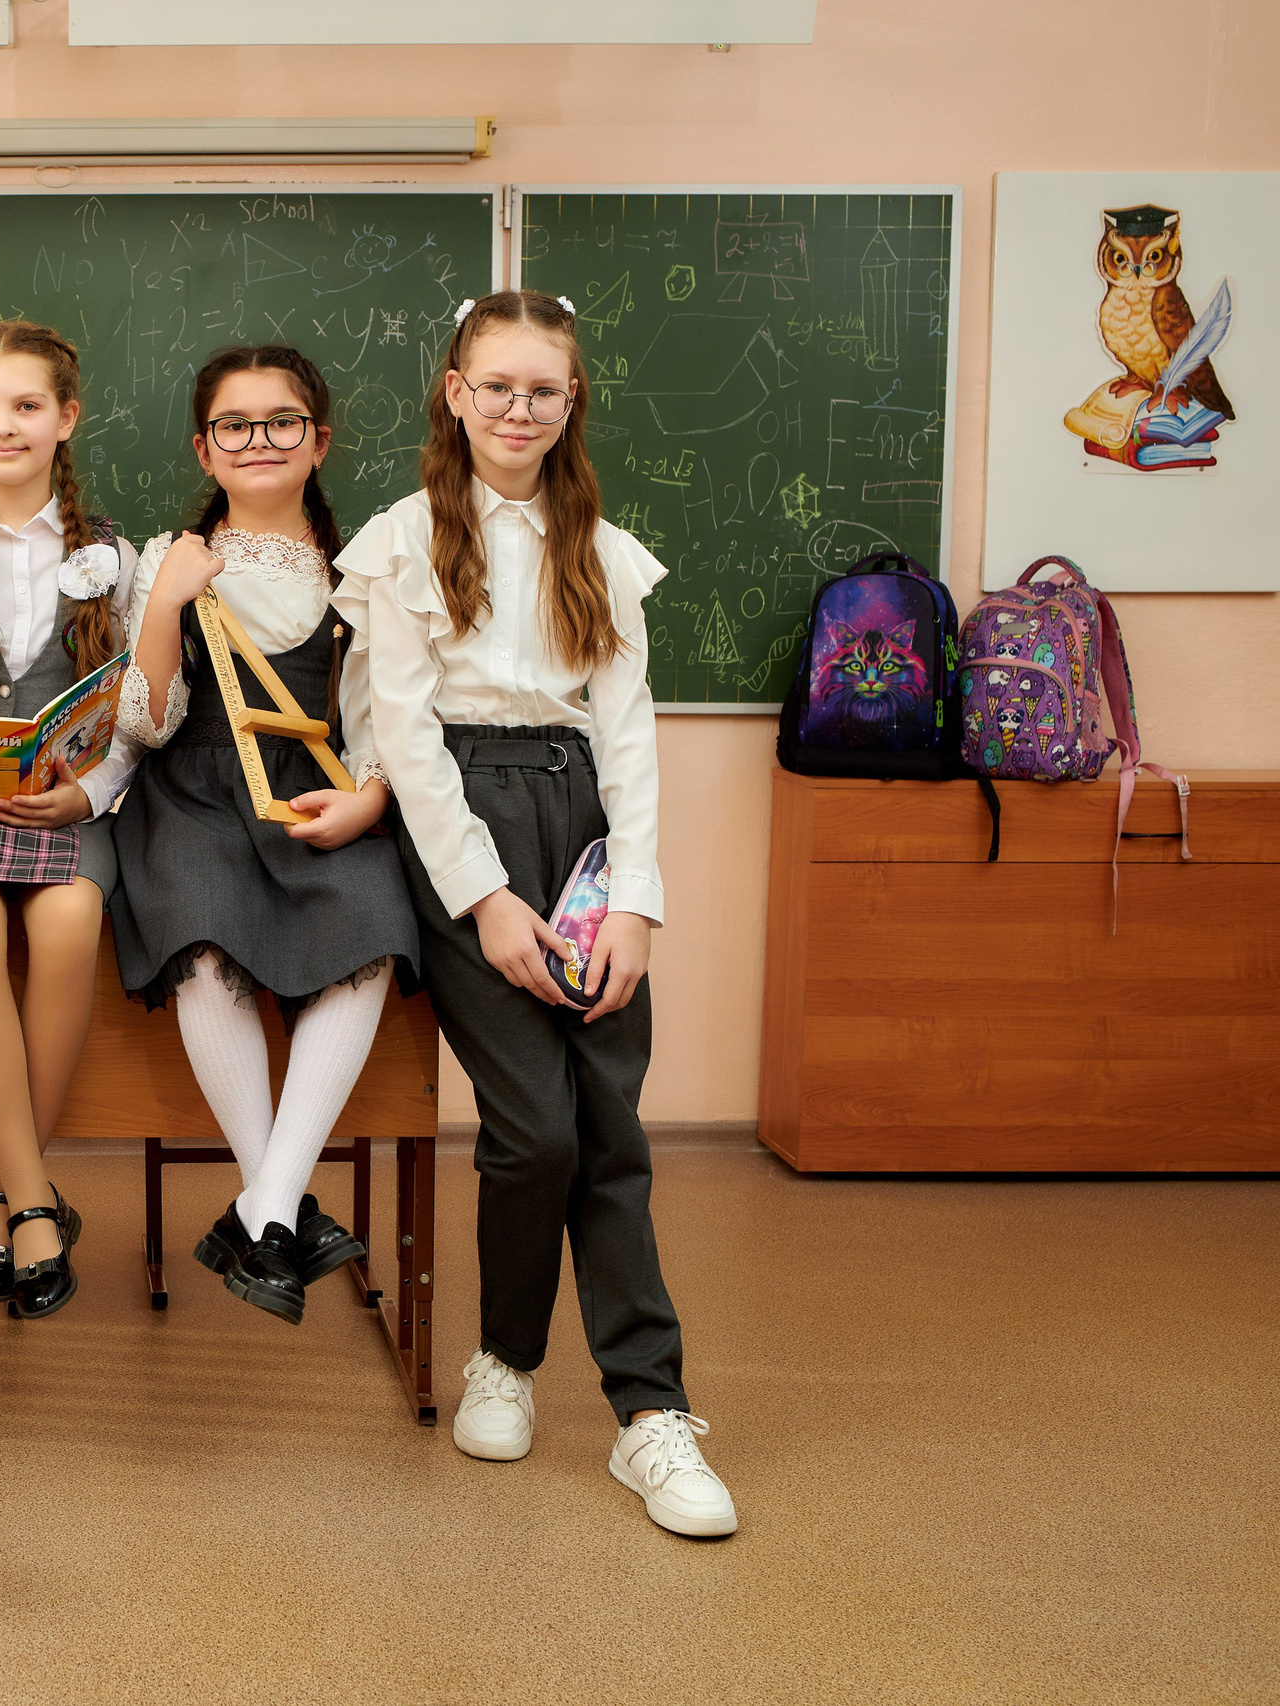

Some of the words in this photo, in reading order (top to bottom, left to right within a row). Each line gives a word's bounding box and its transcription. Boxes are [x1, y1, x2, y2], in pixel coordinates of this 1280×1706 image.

[120, 238, 192, 300] Yes
[104, 675, 114, 689] 4
[40, 712, 72, 745] ЯЗЫК
[41, 683, 99, 735] РУССКИЙ
